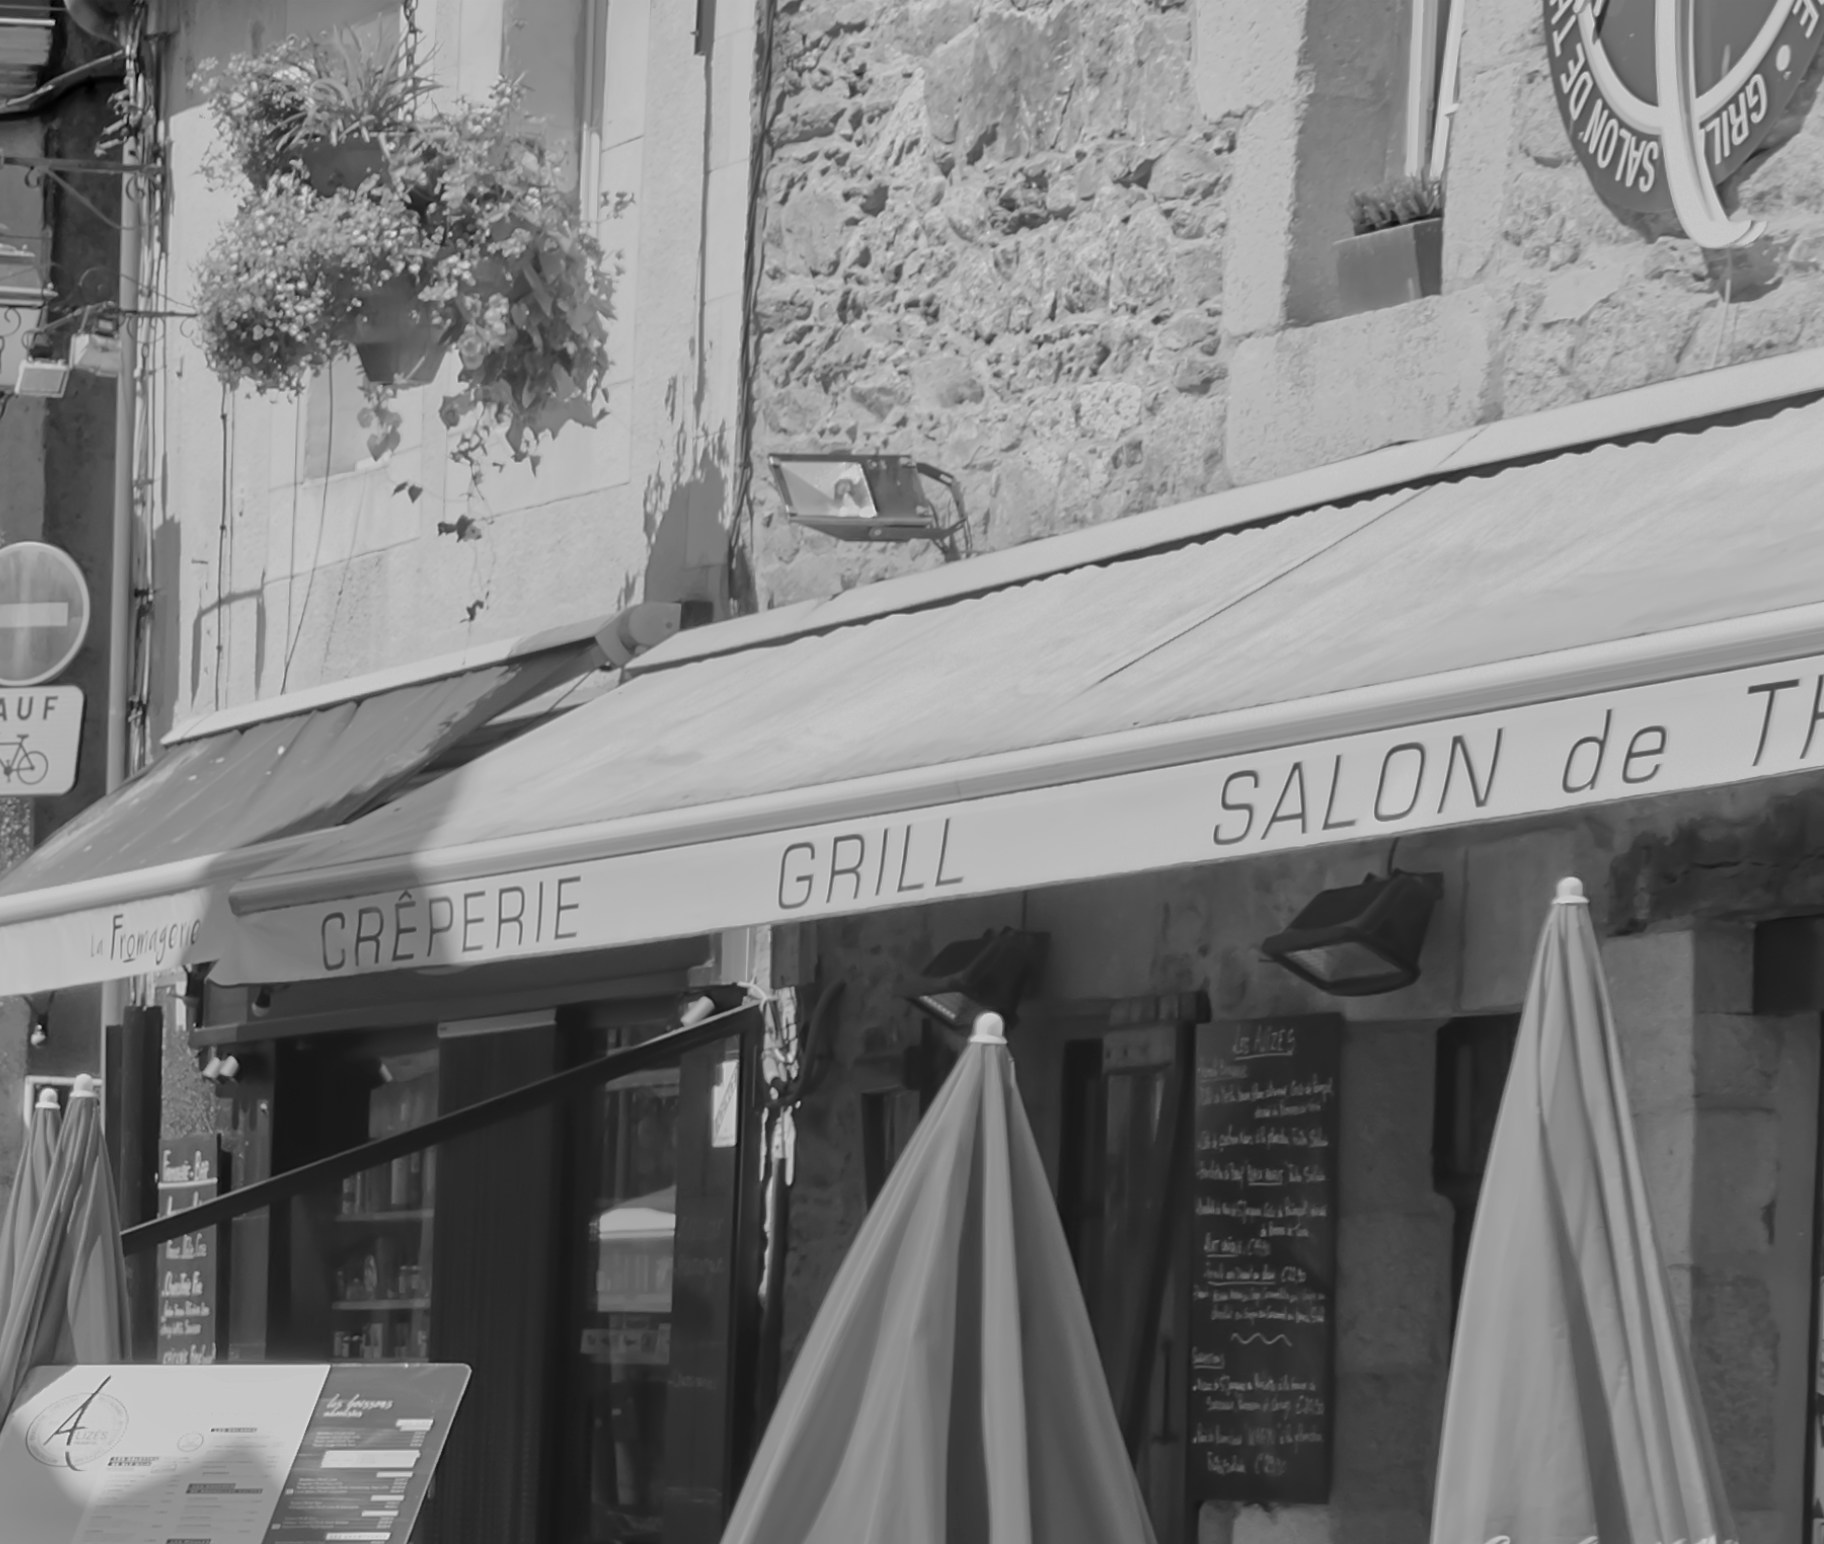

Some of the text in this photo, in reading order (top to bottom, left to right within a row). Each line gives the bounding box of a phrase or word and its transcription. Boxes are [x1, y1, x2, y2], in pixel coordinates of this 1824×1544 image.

[1211, 726, 1505, 848] SALON
[1560, 708, 1669, 796] de
[777, 818, 965, 911] GRILL
[110, 913, 202, 966] Fromagerie
[320, 875, 583, 972] CRÊPERIE
